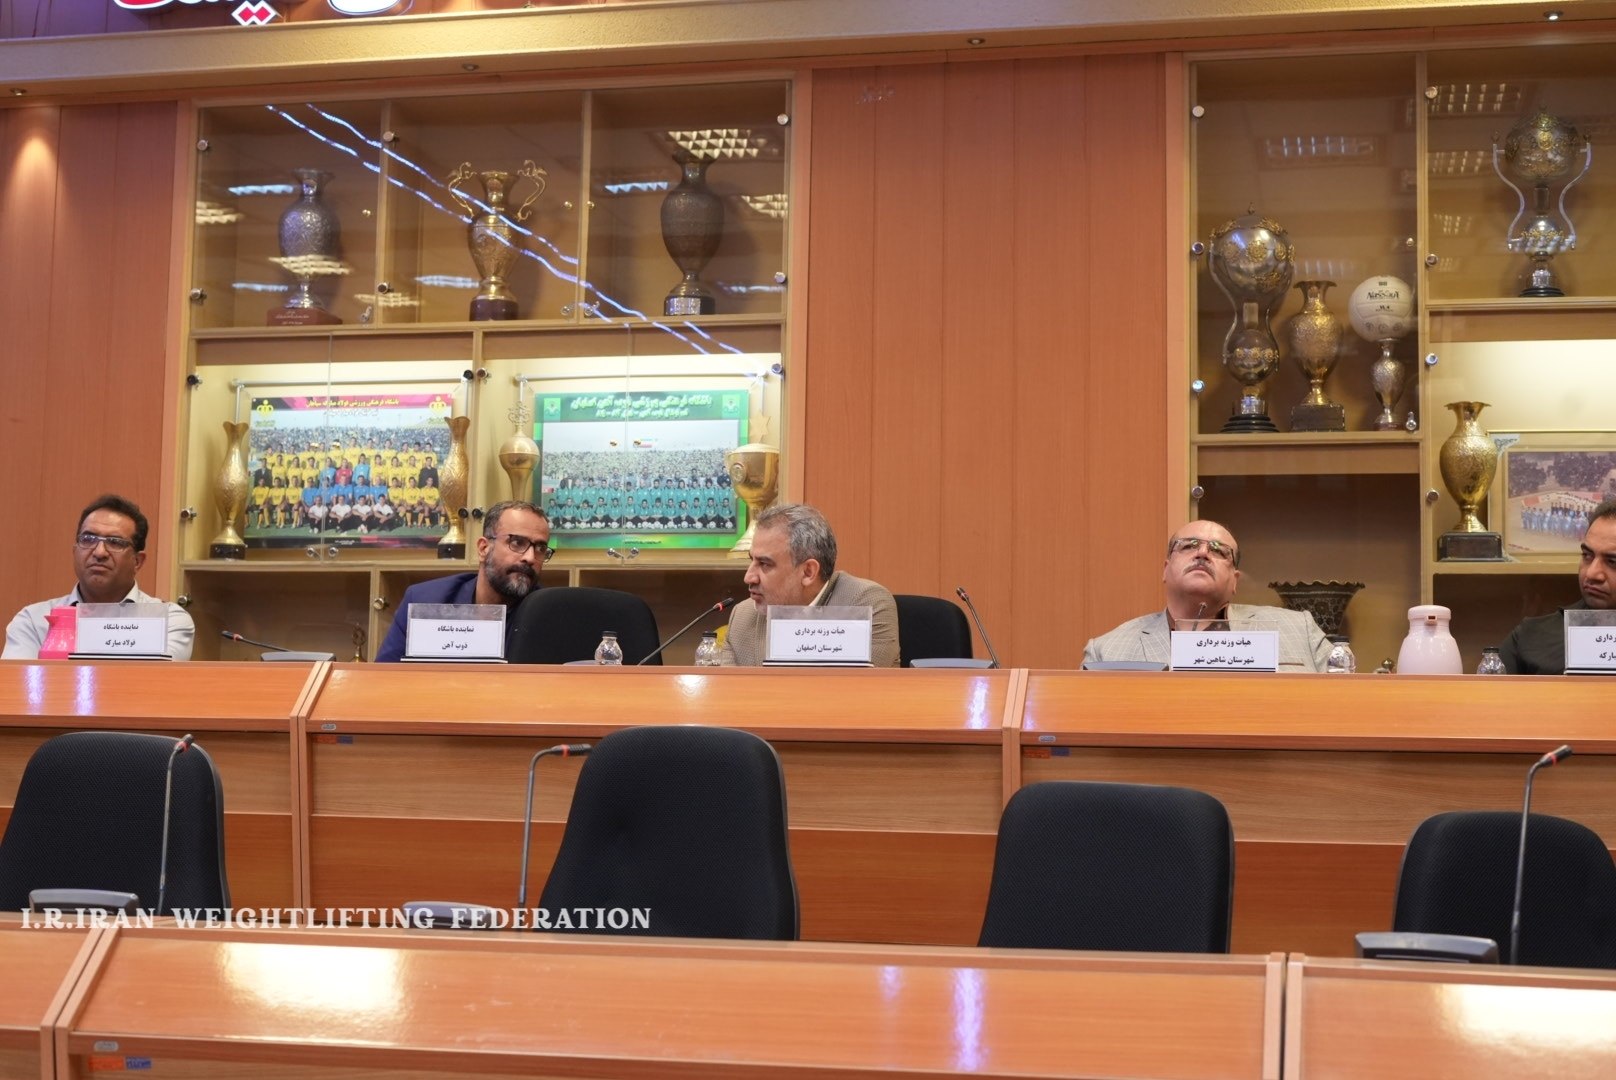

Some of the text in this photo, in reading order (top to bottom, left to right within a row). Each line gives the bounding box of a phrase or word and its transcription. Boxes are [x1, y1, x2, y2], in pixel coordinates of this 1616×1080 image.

[120, 624, 139, 632] نماینده
[437, 625, 474, 633] نماینده باشگاه
[794, 627, 815, 636] برداری
[817, 627, 830, 636] وزنه
[1196, 638, 1219, 647] برداری
[1220, 638, 1235, 647] وزنه
[1595, 633, 1616, 643] رداری
[105, 639, 136, 648] فولاد مبارکه
[441, 641, 468, 650] ذوب آهن
[796, 644, 843, 653] شهرستان اصفهان
[1193, 656, 1255, 665] شهرستان شاهین شهر
[1599, 651, 1616, 661] بارکه
